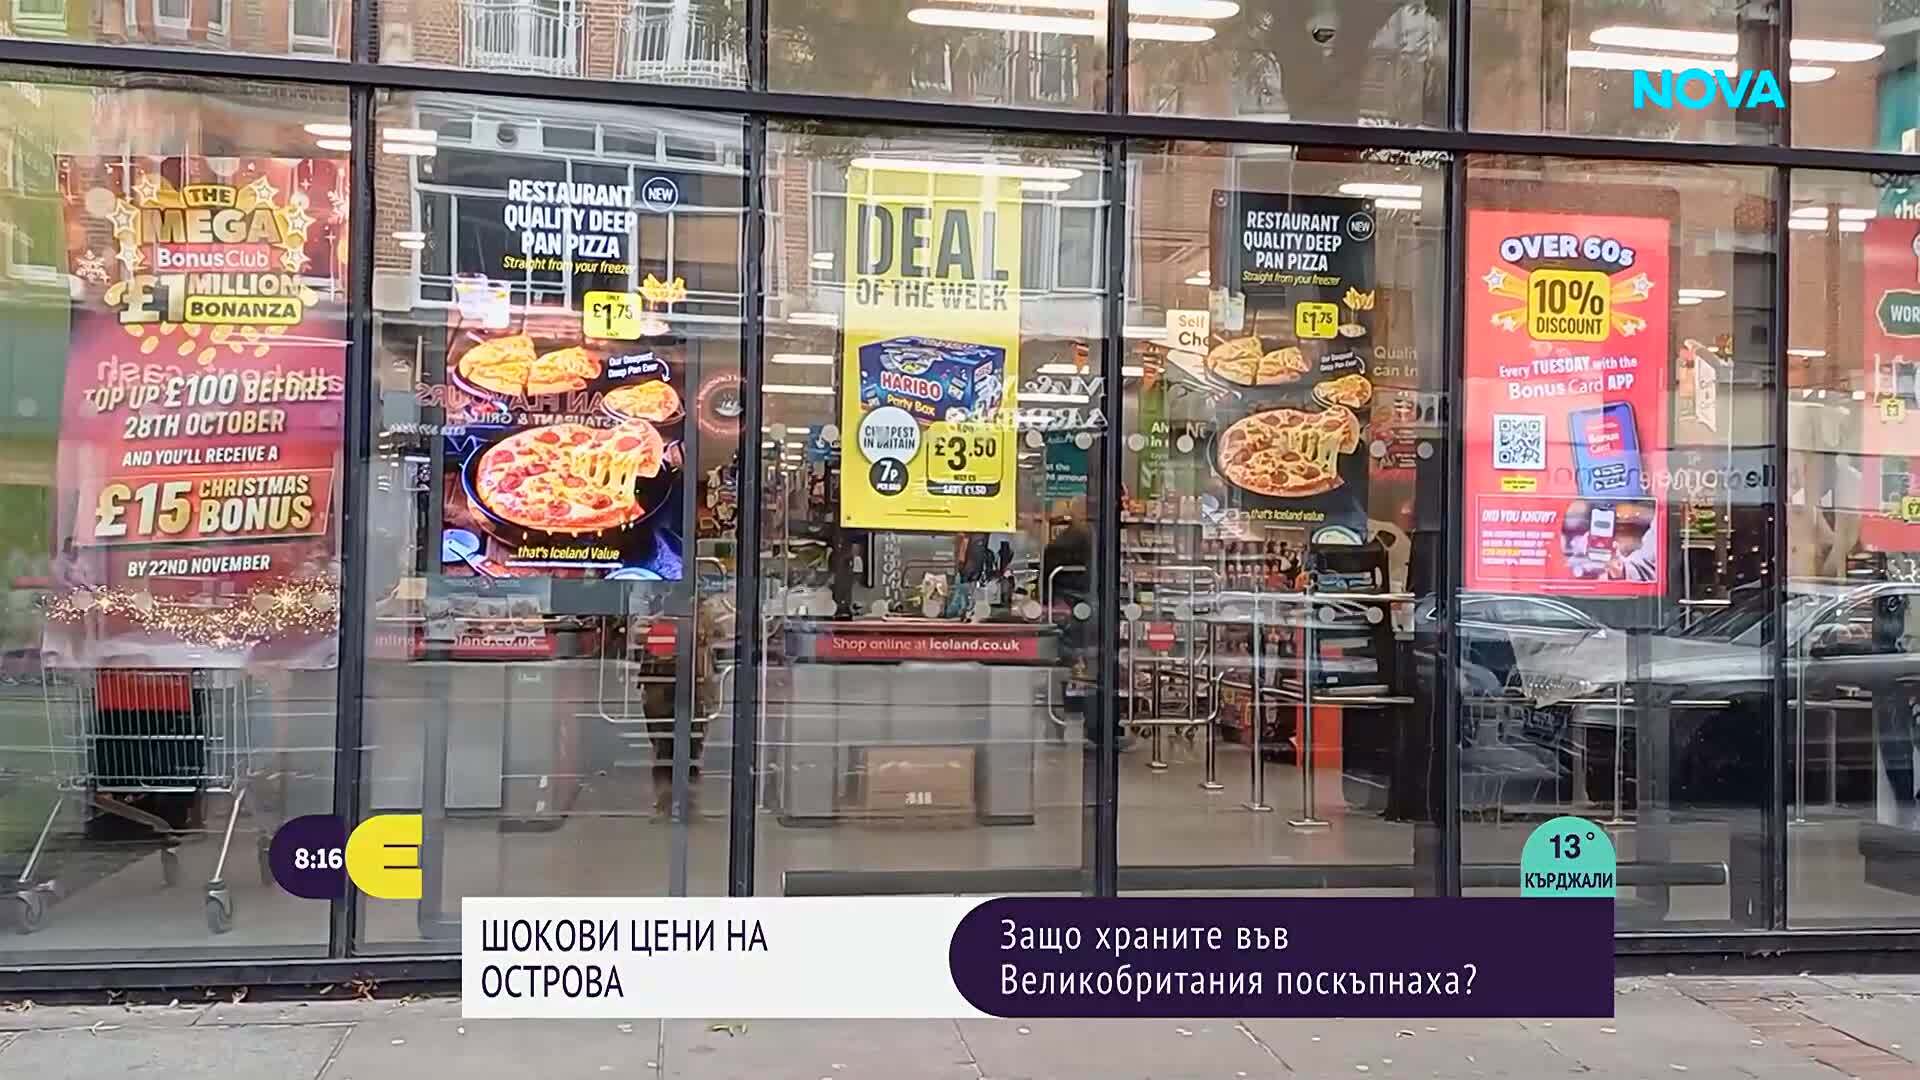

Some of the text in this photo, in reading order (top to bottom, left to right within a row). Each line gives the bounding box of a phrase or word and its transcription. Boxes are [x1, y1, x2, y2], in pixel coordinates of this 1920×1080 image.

[189, 188, 231, 203] THE
[508, 179, 634, 208] RESTAURANT
[648, 187, 674, 202] NEW
[142, 208, 282, 243] MEGA
[504, 205, 638, 234] QUALITY DEEP
[1247, 210, 1341, 233] RESTAURANT
[1351, 220, 1370, 233] NEW
[521, 231, 621, 259] PAN PIZZA
[857, 204, 1009, 281] DEAL
[1243, 231, 1342, 252] QUALITY DEEP
[1500, 234, 1634, 267] OVER 60s
[157, 248, 270, 268] BonusClub
[503, 256, 546, 271] Straight
[574, 261, 602, 275] your
[1255, 252, 1328, 271] PAN PIZZA
[1242, 270, 1341, 286] Straight from your freezer
[120, 273, 302, 323] £1 MILLION
[857, 278, 1008, 310] OF THE WEEK
[1534, 279, 1604, 316] 10%
[190, 302, 297, 318] BONANZA
[593, 303, 633, 330] £1.75
[1302, 311, 1333, 332] £1.75
[1536, 316, 1603, 335] DISCOUNT
[609, 357, 622, 367] Our
[1499, 356, 1638, 379] Every TUESDAY with the
[84, 383, 124, 413] TOP
[129, 384, 160, 410] UP
[163, 373, 239, 408] £100
[242, 375, 330, 404] BEFORE
[880, 371, 943, 402] HARIBO
[1508, 373, 1633, 400] Bonus Card APP
[887, 394, 937, 417] Party Box
[123, 409, 286, 440] 28TH OCTOBER
[864, 437, 875, 449] IN
[935, 436, 996, 471] £3.50
[122, 447, 278, 467] AND YOU'LL RECEIVE A
[199, 475, 309, 499] CHRISTMAS
[94, 480, 192, 538] £15
[199, 496, 313, 534] BONUS
[1482, 510, 1557, 523] DID YOU KNOW?
[549, 547, 590, 559] Iceland
[591, 548, 620, 560] Value
[128, 555, 270, 577] BY 22ND NOVEMBER
[832, 637, 865, 652] Shop
[869, 638, 912, 651] online
